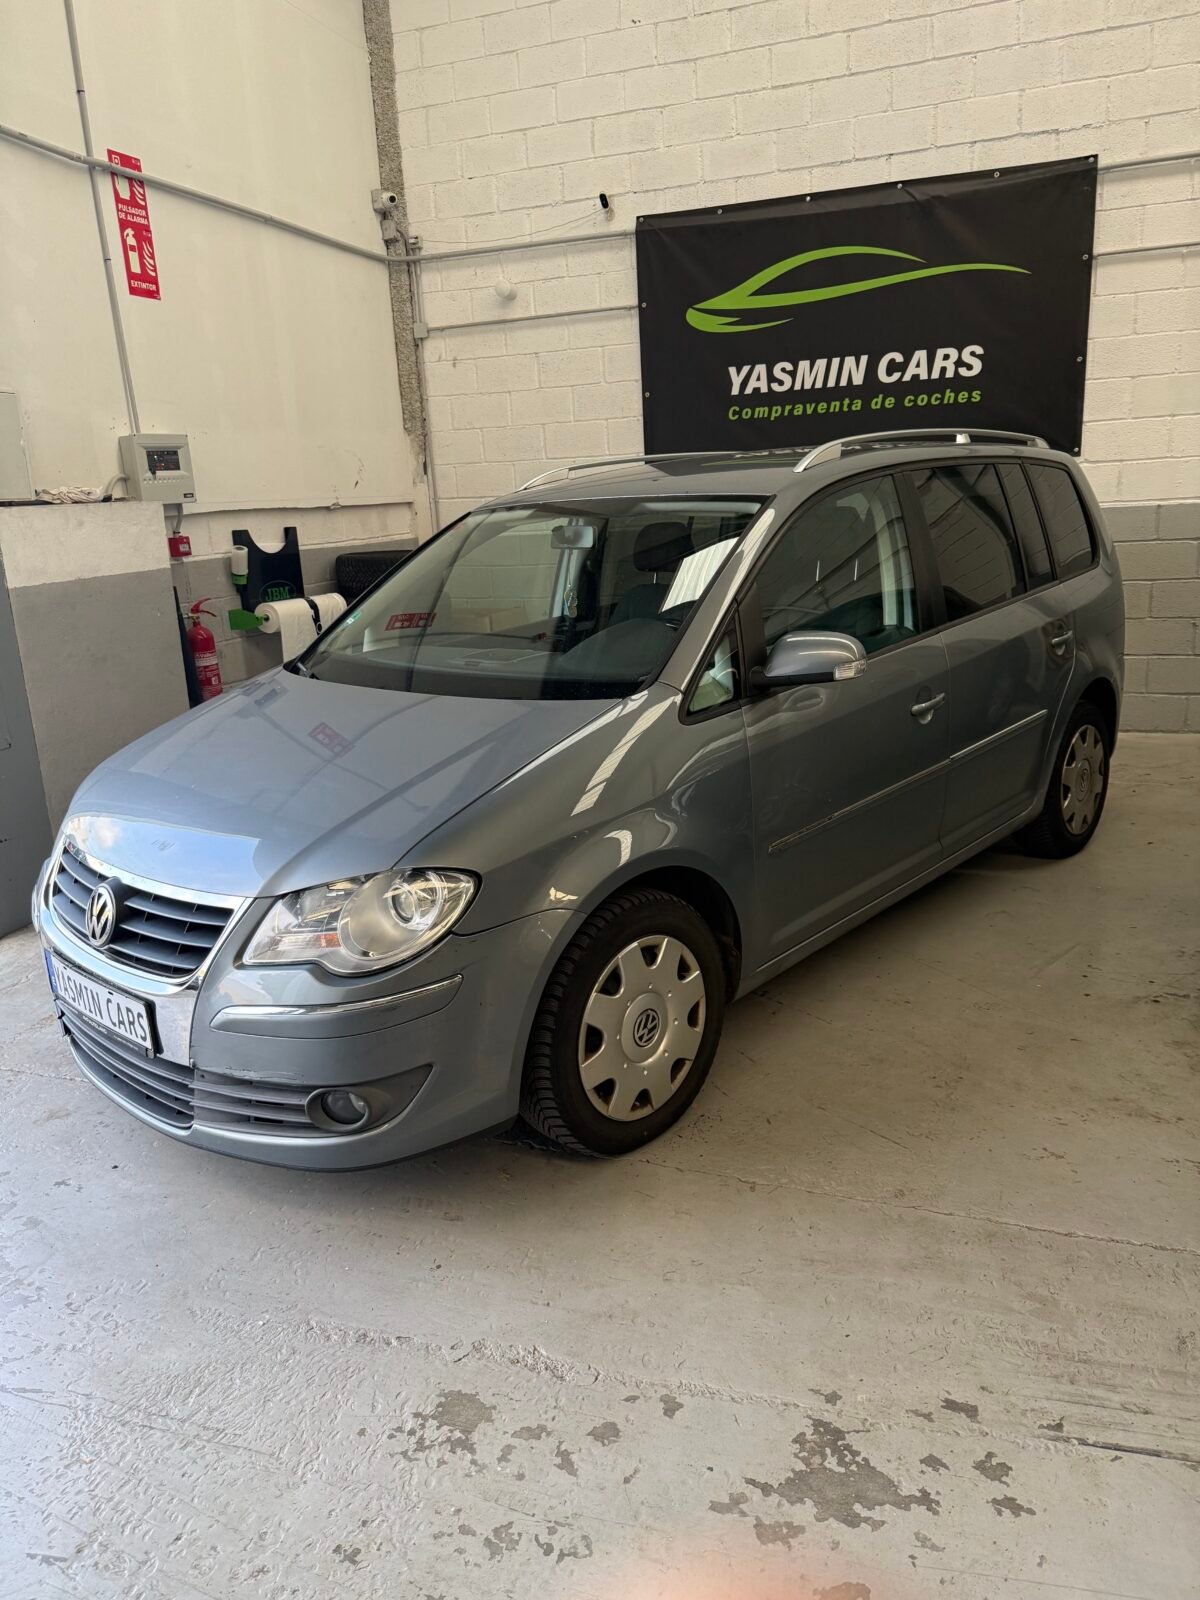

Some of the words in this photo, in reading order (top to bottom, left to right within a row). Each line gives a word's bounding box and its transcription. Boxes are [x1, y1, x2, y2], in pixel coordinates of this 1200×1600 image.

[118, 203, 147, 217] PULSADOR
[118, 211, 126, 220] DE
[127, 213, 149, 225] ALARMA
[131, 279, 157, 291] EXTINTOR
[727, 354, 869, 396] YASMIN
[877, 344, 985, 384] CARS
[728, 396, 862, 421] Compraventa
[871, 394, 895, 410] de
[904, 388, 982, 407] coches
[265, 586, 290, 602] JBM
[54, 966, 104, 1020] YASMIN
[106, 997, 148, 1043] CARS
